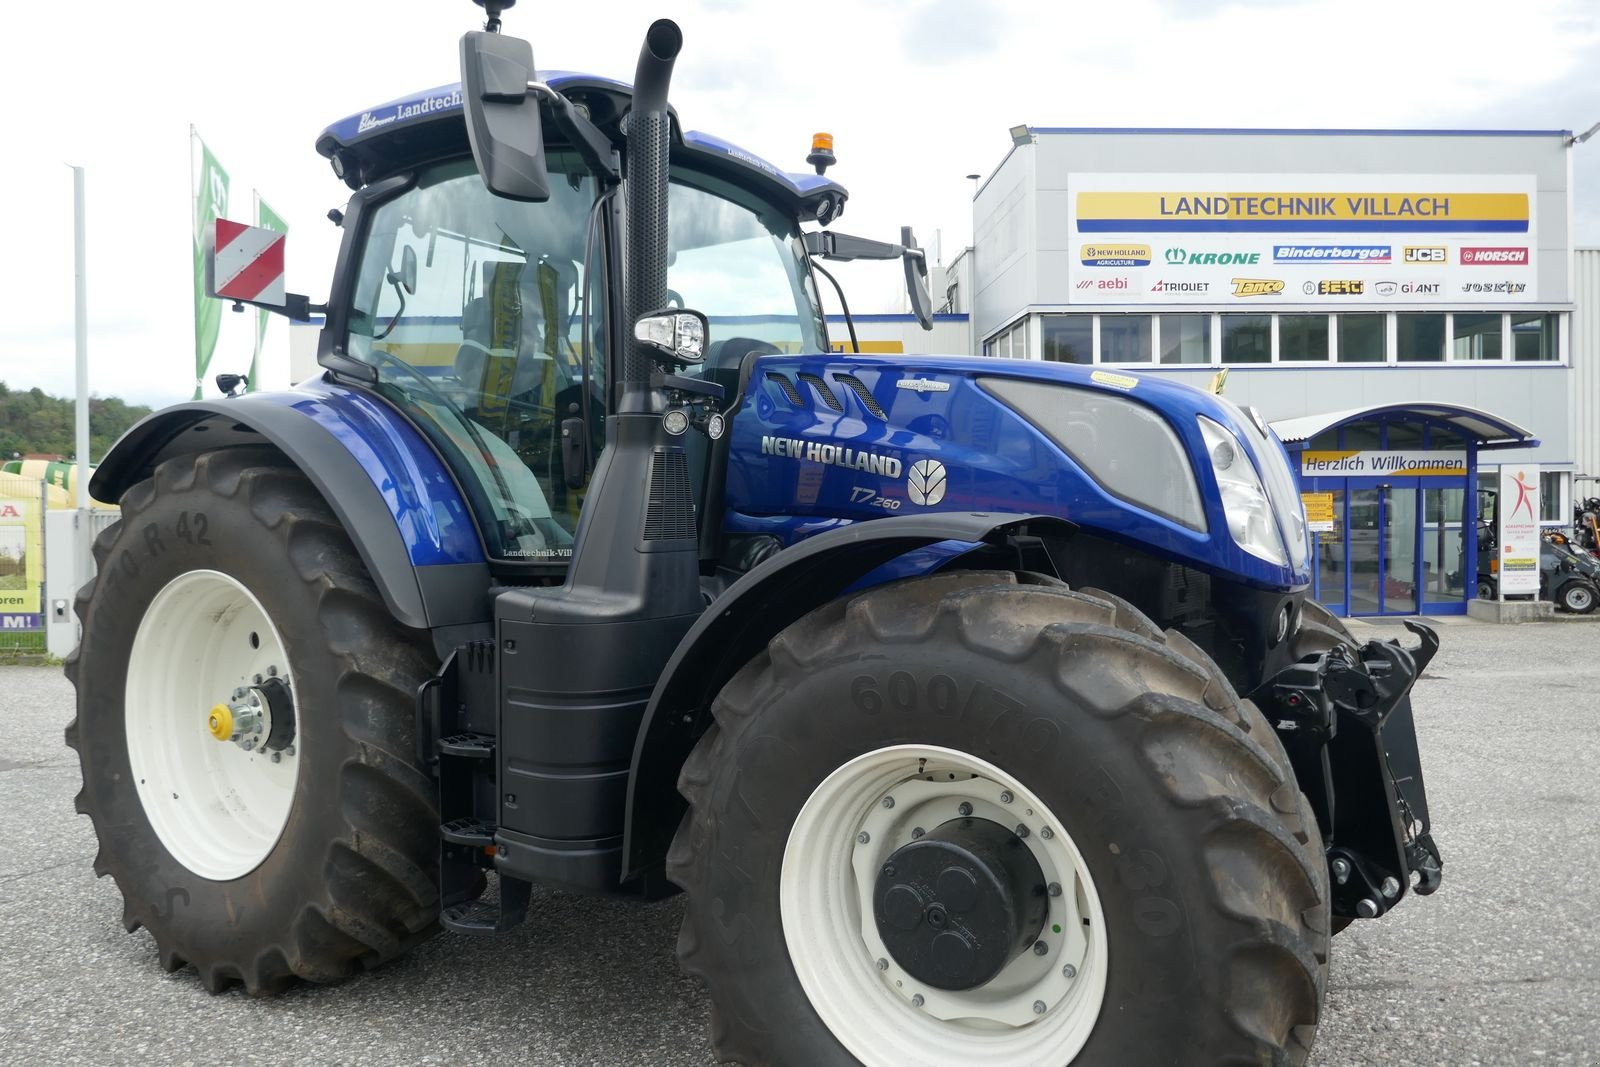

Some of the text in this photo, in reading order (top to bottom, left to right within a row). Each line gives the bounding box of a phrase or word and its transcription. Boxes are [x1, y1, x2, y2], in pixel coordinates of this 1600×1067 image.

[1160, 197, 1450, 217] LANDTECHNIK VILLACH
[1188, 253, 1261, 265] KRONE
[1276, 247, 1389, 260] Binderberger
[1406, 248, 1446, 262] JCB
[1474, 251, 1525, 262] HORSCH
[1098, 278, 1128, 289] aebi
[1163, 282, 1210, 292] TRIOLIET
[1231, 278, 1285, 297] Tanco
[1462, 281, 1526, 294] JOSKIN
[761, 435, 902, 479] NEW HOLLAND
[1306, 456, 1463, 471] Herzlich Willkommen
[176, 511, 213, 546] 42
